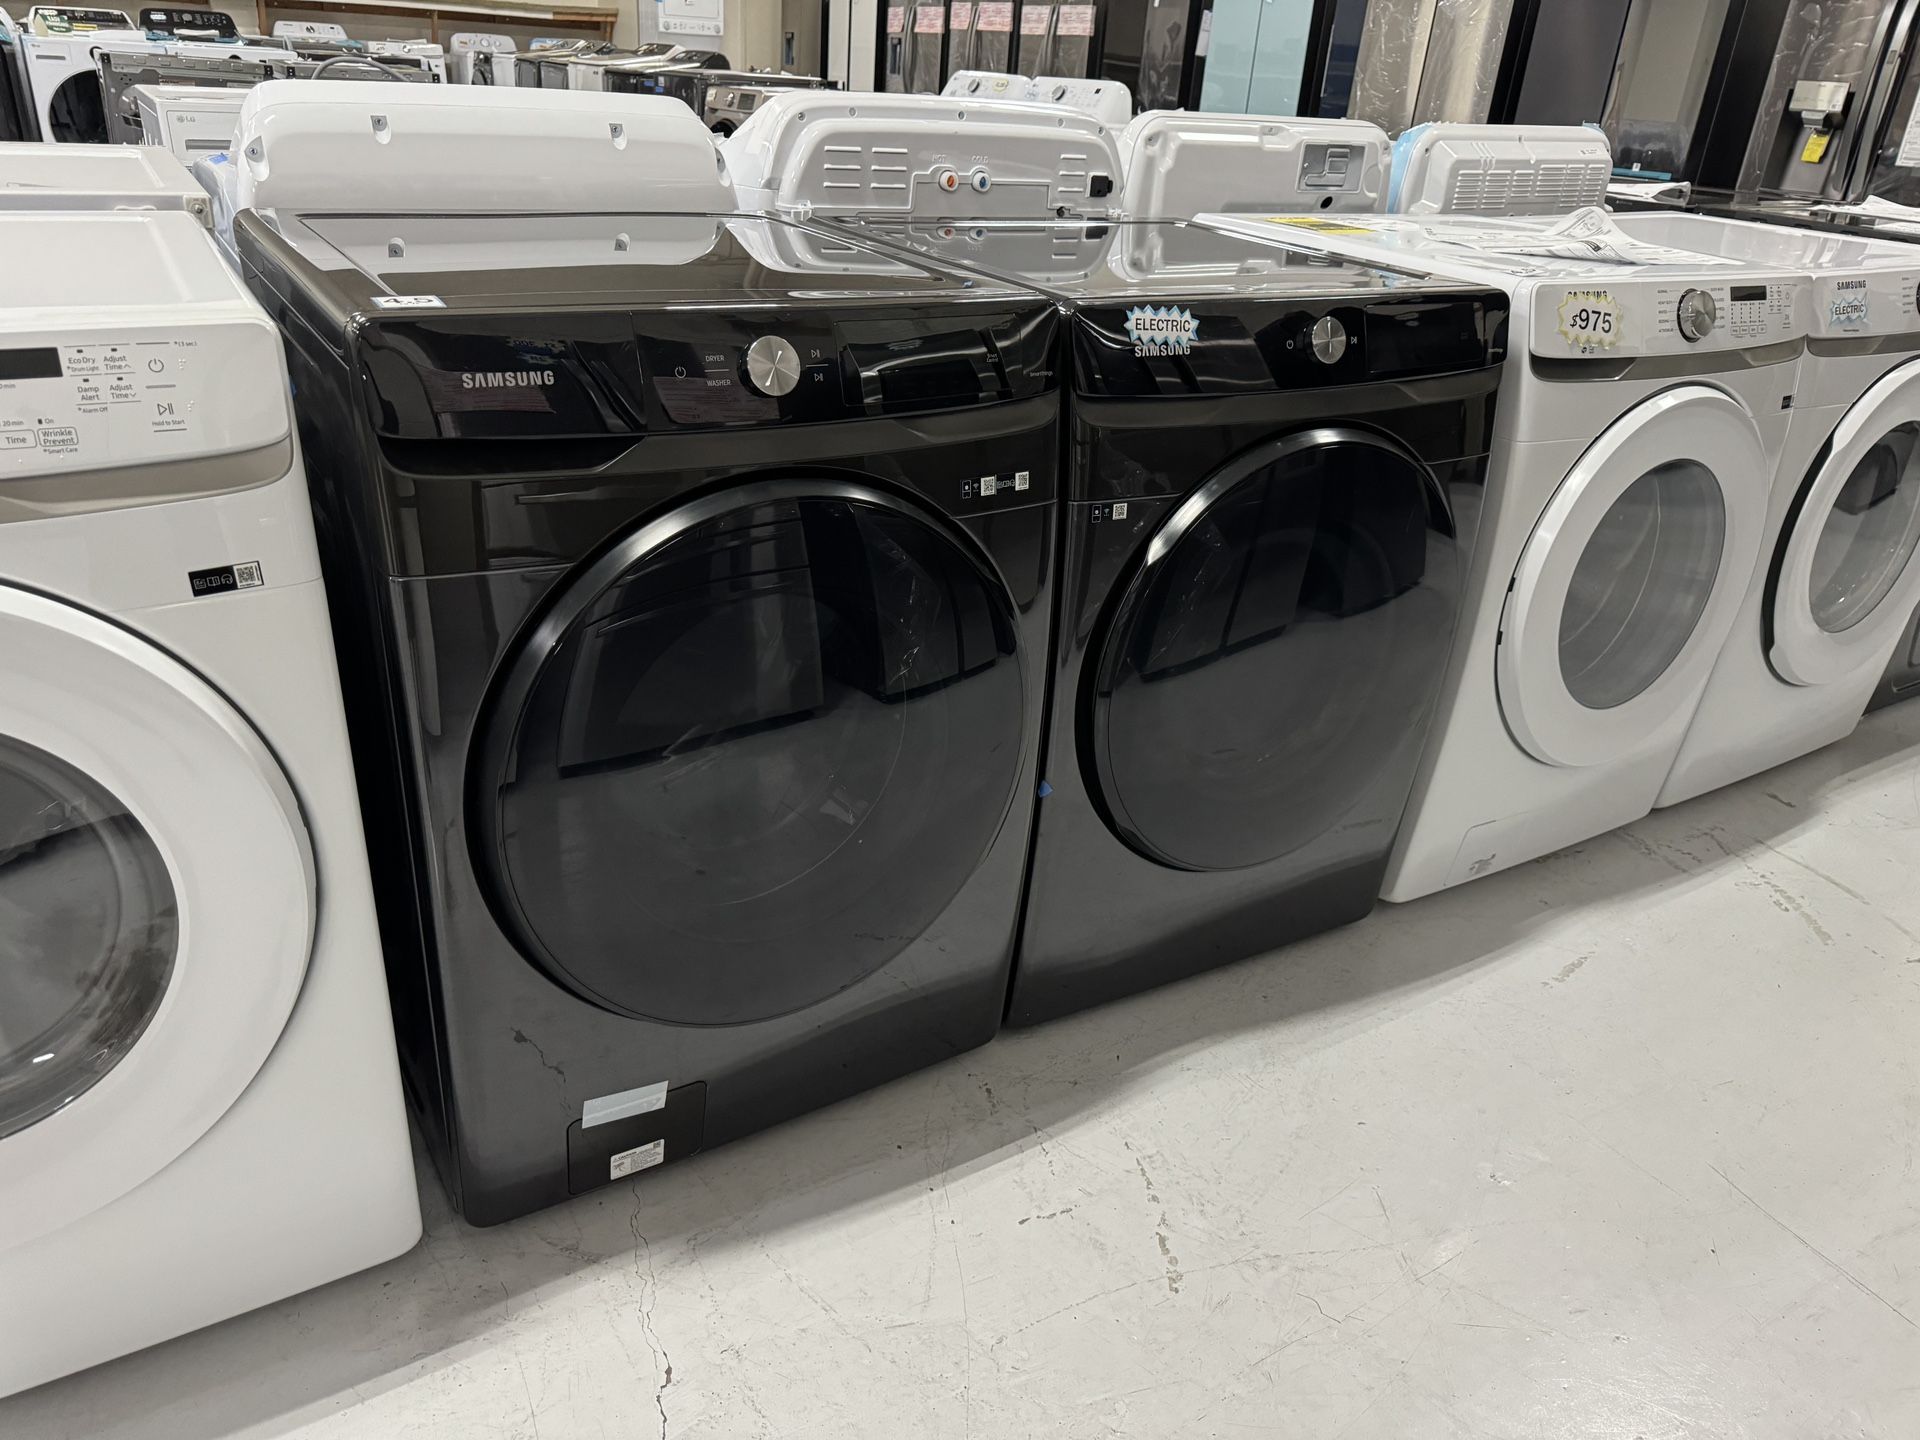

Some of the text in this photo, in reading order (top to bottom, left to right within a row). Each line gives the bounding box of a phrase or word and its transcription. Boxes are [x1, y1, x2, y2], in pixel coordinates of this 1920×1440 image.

[1837, 280, 1867, 290] SAMSUNG
[1834, 303, 1865, 316] ELECTRIC
[1135, 317, 1191, 333] ELECTRIC
[1569, 308, 1612, 334] $975
[1134, 344, 1191, 358] SAMSUNG
[82, 356, 96, 365] Dry
[103, 355, 127, 364] Adjust
[705, 354, 725, 362] DRYER
[104, 363, 123, 371] Time
[461, 370, 555, 389] SAMSUNG
[706, 379, 731, 387] WASHER
[77, 386, 100, 394] Damp
[109, 384, 133, 392] Adjust
[80, 393, 100, 401] Alert
[110, 392, 129, 400] Time
[41, 429, 73, 438] Wrinkle
[5, 436, 27, 444] Time
[43, 437, 75, 446] Prevent
